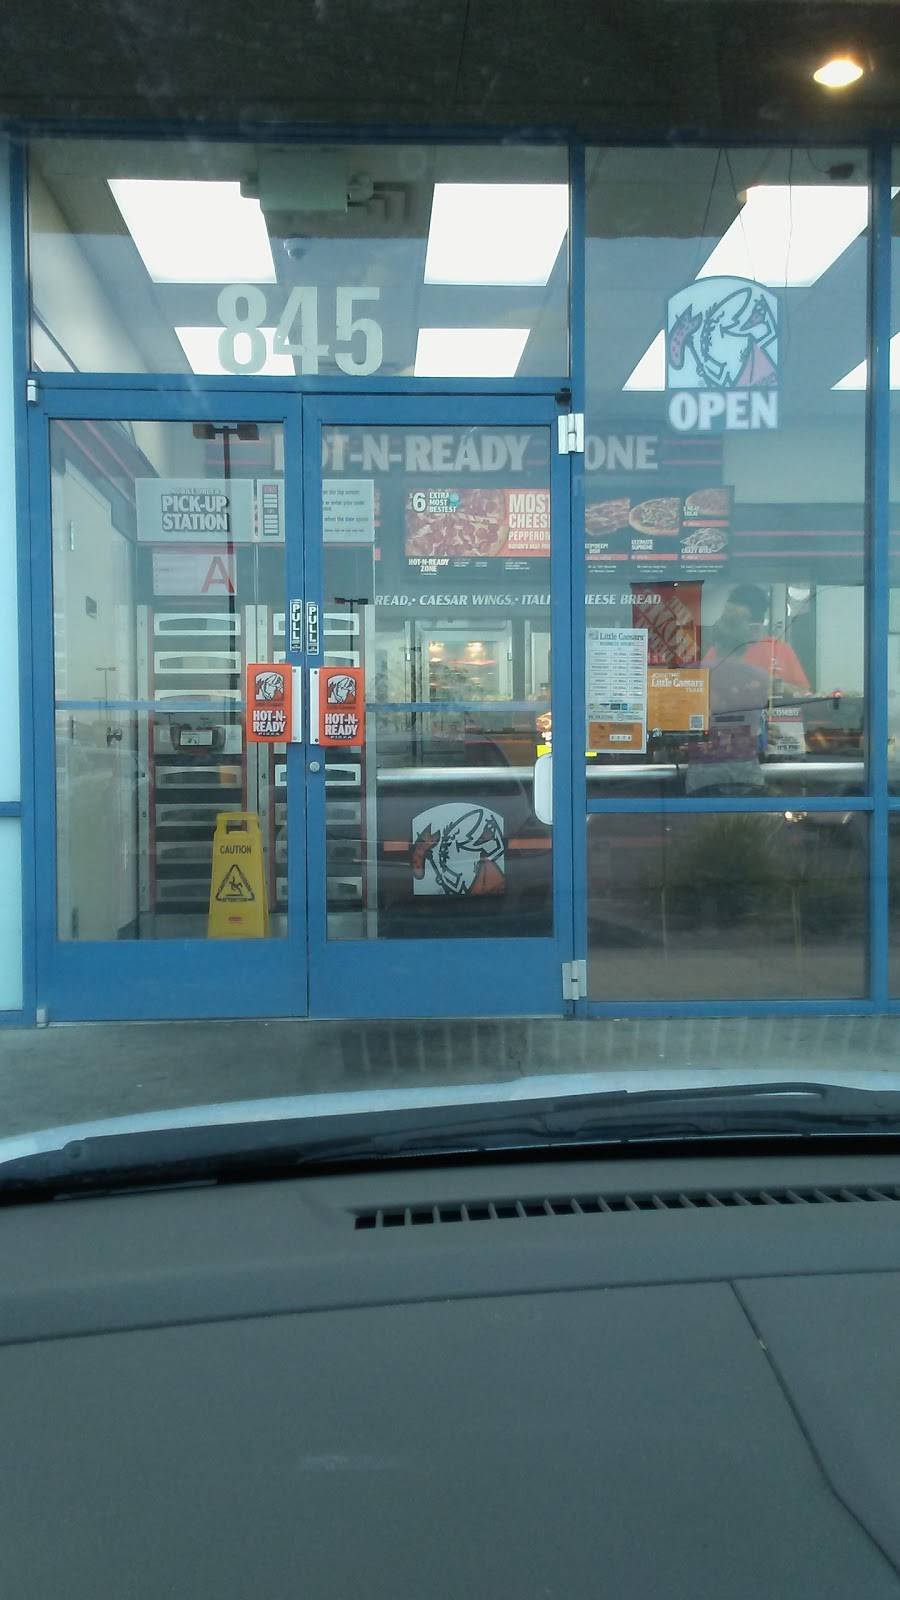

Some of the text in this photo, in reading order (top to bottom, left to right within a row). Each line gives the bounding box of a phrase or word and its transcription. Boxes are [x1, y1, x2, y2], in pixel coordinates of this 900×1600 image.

[216, 283, 383, 376] 845
[668, 391, 778, 431] OPEN
[584, 434, 658, 471] ONE
[161, 494, 228, 512] PICK-UP
[429, 505, 457, 513] BESTEST
[161, 512, 229, 531] STATION
[509, 513, 550, 529] CHEES
[408, 558, 450, 566] HOT-N-READY
[420, 565, 438, 573] ZONE
[201, 556, 235, 593] A
[419, 594, 468, 606] CAESAR
[620, 594, 662, 606] BREAD
[292, 603, 301, 640] PULL
[309, 606, 317, 643] PULL
[252, 710, 287, 721] HOT-N-
[324, 713, 359, 725] HOT-N-
[252, 721, 286, 733] READY
[324, 724, 358, 736] READY
[219, 845, 252, 855] CAUTION
